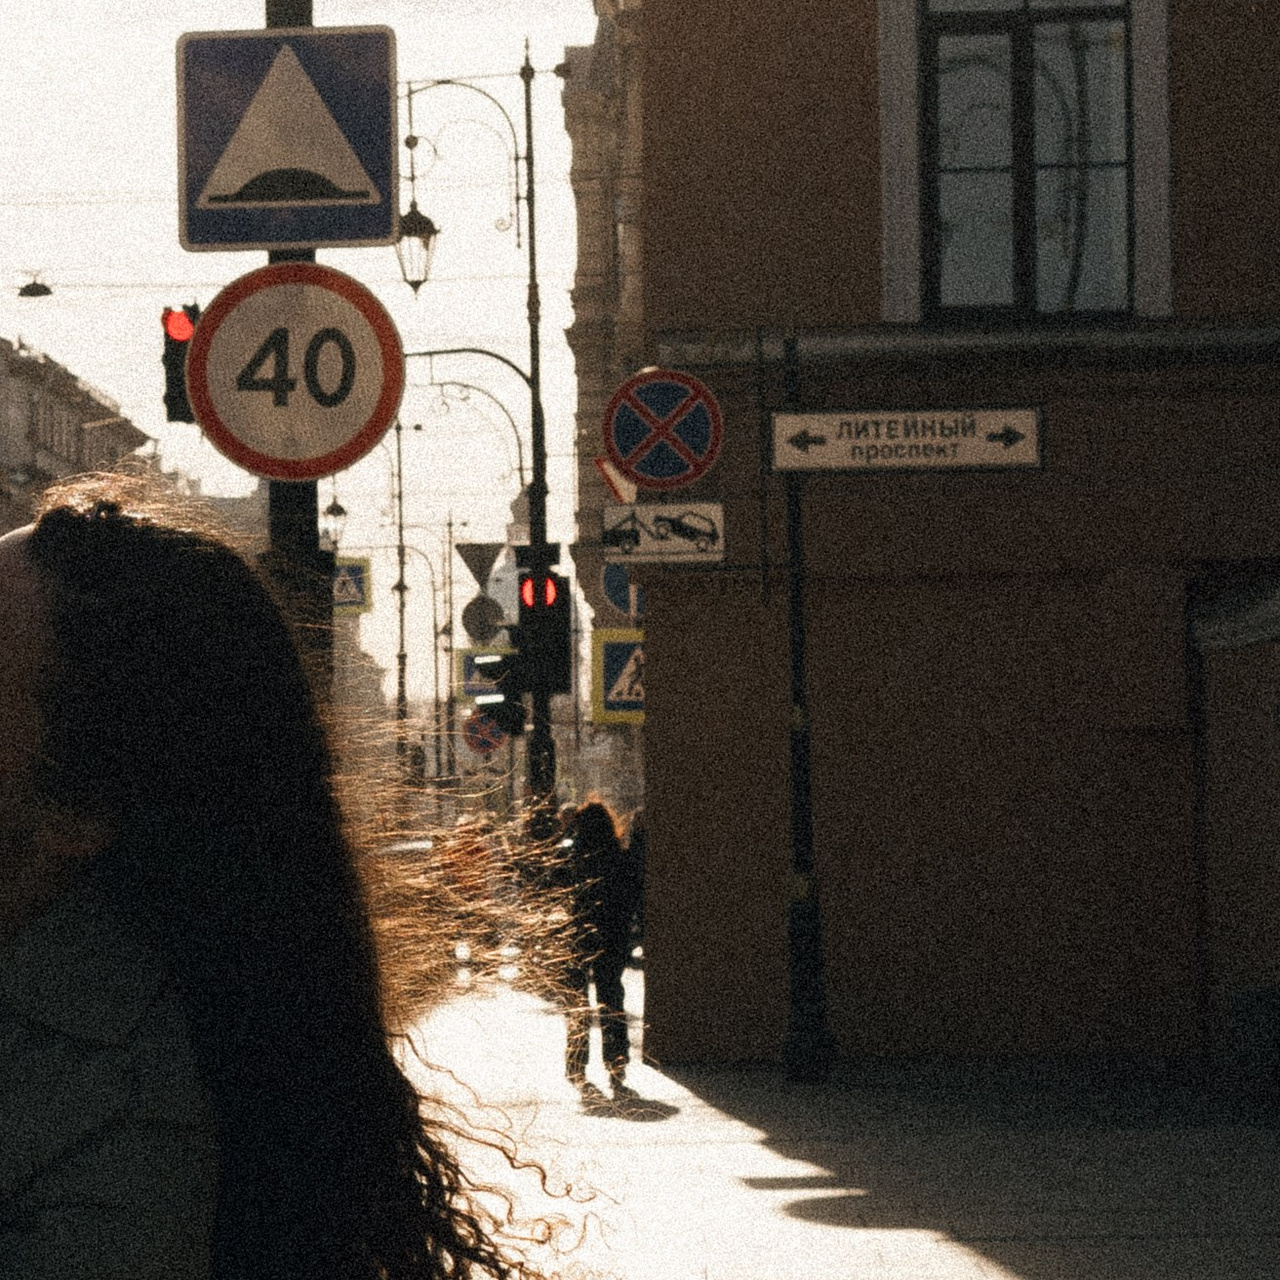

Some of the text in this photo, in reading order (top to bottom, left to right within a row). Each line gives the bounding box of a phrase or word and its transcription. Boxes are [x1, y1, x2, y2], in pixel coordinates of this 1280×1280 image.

[236, 327, 356, 407] 40
[837, 416, 976, 439] ЛИТЕЙНЫЙ
[850, 442, 959, 464] проспект
